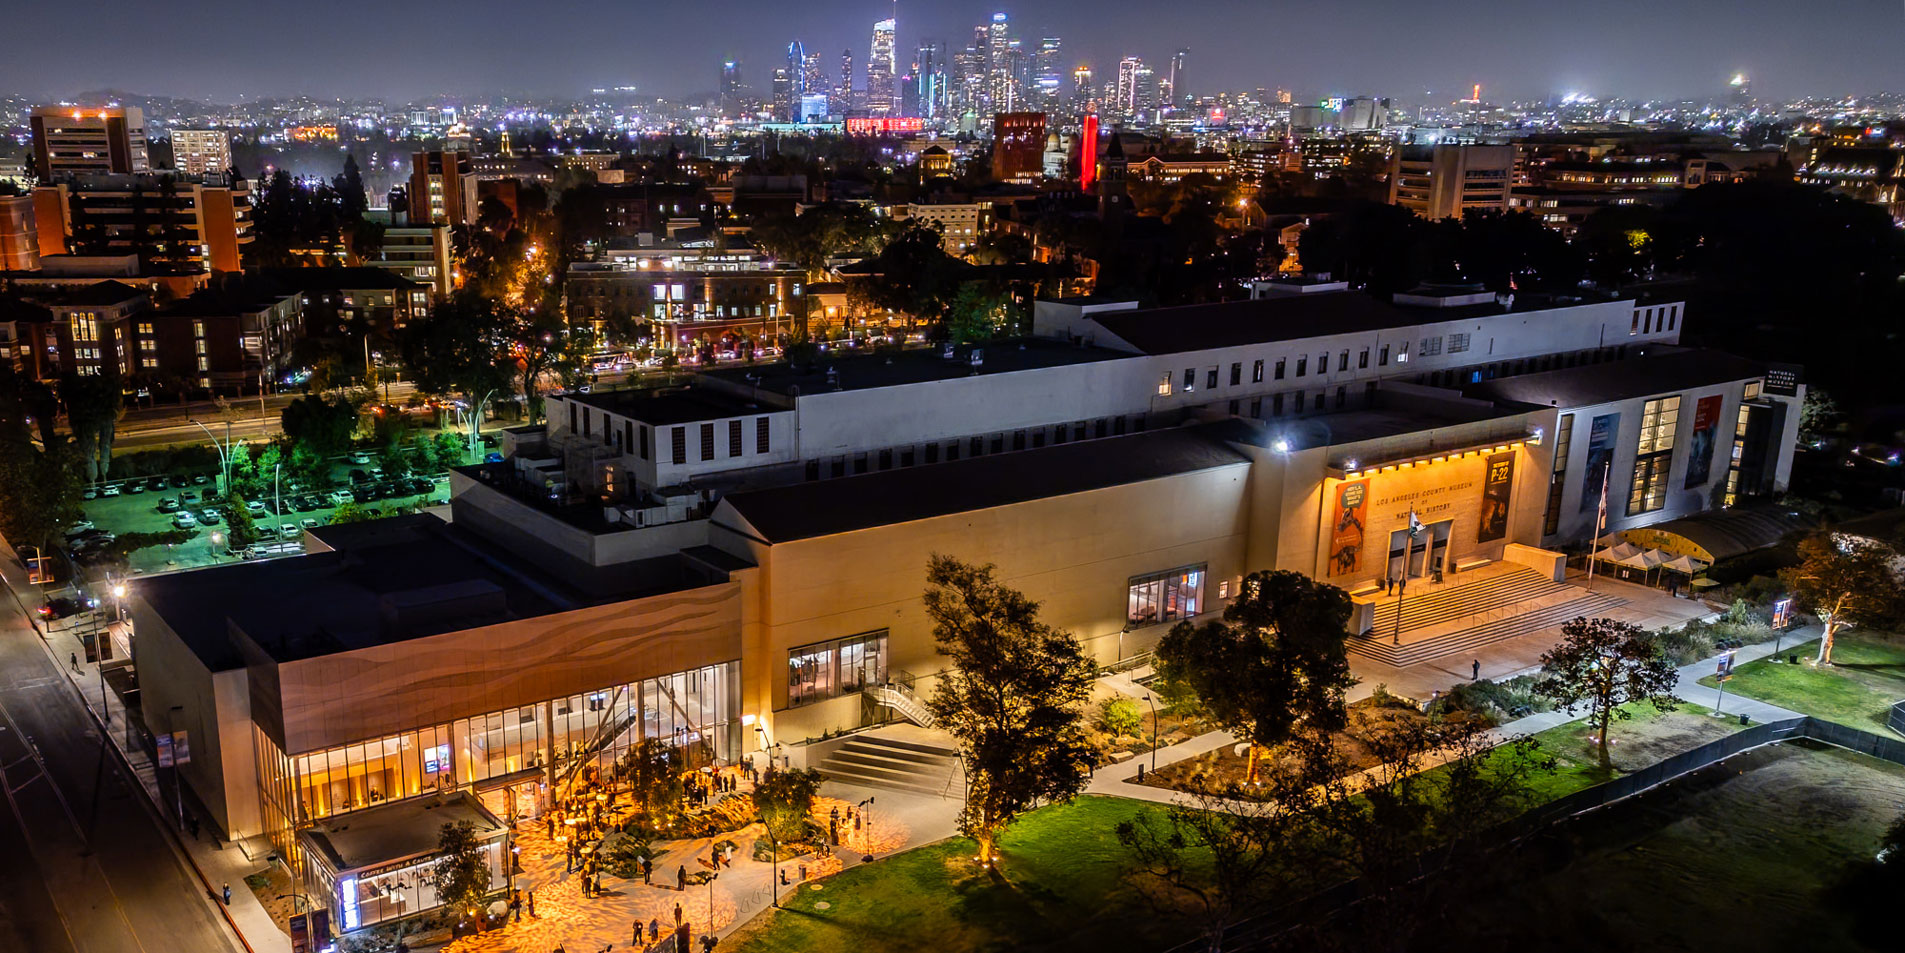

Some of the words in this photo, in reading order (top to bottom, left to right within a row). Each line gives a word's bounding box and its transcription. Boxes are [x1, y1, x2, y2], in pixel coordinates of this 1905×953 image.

[1490, 466, 1509, 482] P-22
[1376, 498, 1389, 506] LOS
[1392, 492, 1420, 503] ANGELES
[1422, 487, 1446, 497] COUNTY
[1449, 481, 1473, 491] MUSEUM
[1396, 508, 1423, 519] NATUAL
[1426, 503, 1451, 514] HISTORY
[386, 863, 403, 872] WITH
